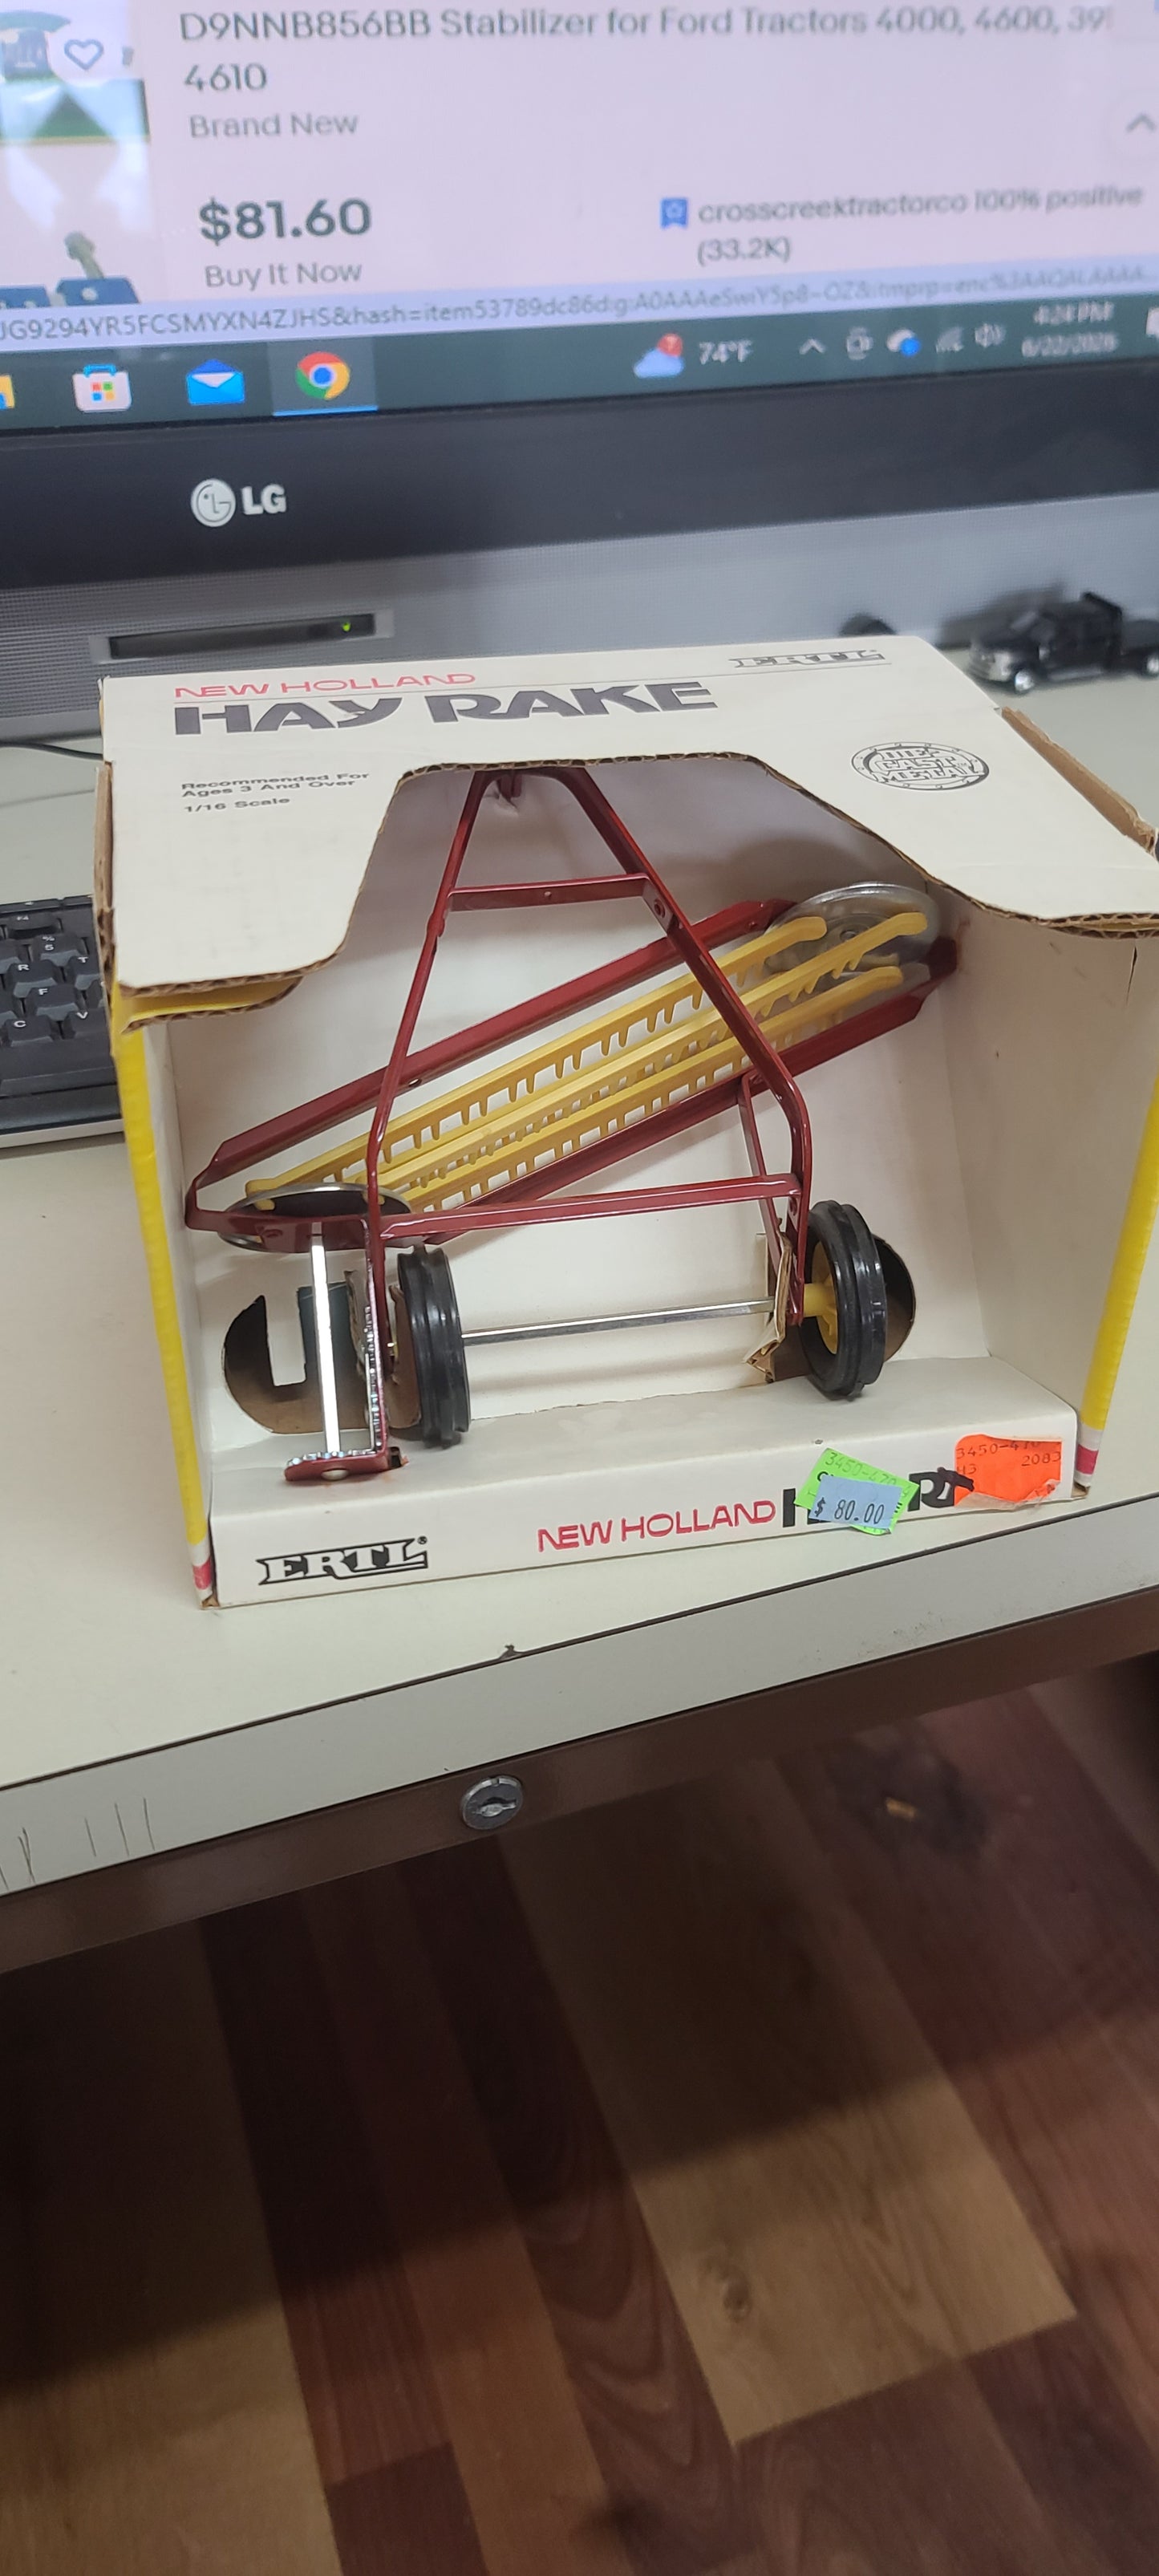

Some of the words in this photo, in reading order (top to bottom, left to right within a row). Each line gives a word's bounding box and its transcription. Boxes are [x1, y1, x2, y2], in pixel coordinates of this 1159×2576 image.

[180, 10, 431, 41] D9NNB856BB
[440, 9, 594, 39] Stabilizer
[607, 7, 648, 36] for
[661, 7, 733, 35] Ford
[743, 6, 867, 34] Tractors
[875, 6, 965, 35] 4000,
[976, 6, 1059, 34] 4600,
[184, 63, 268, 91] 4610
[189, 113, 281, 139] Brand
[291, 113, 358, 136] New
[698, 193, 967, 224] crosscreektractorco
[975, 189, 1040, 213] 100%
[1046, 186, 1143, 213] positive
[199, 197, 371, 245] $81.60
[697, 236, 791, 266] (33.2K)
[205, 266, 261, 291] Buy
[269, 263, 287, 286] It
[298, 262, 363, 284] Now
[241, 483, 286, 515] LG
[174, 684, 269, 698] NEW
[280, 673, 476, 694] HOLLAND
[174, 697, 403, 735] HAY
[424, 681, 718, 723] RAKE
[872, 765, 986, 784] METAL
[874, 757, 957, 773] CAST
[181, 774, 329, 789] Recommended
[336, 773, 370, 781] For
[181, 787, 233, 798] Ages
[261, 782, 300, 791] And
[308, 780, 355, 788] Over
[184, 804, 227, 813] 1/16
[234, 797, 290, 809] Scale
[834, 1499, 885, 1523] 80.00
[537, 1519, 613, 1552] NEW
[621, 1500, 776, 1542] HOLLAND
